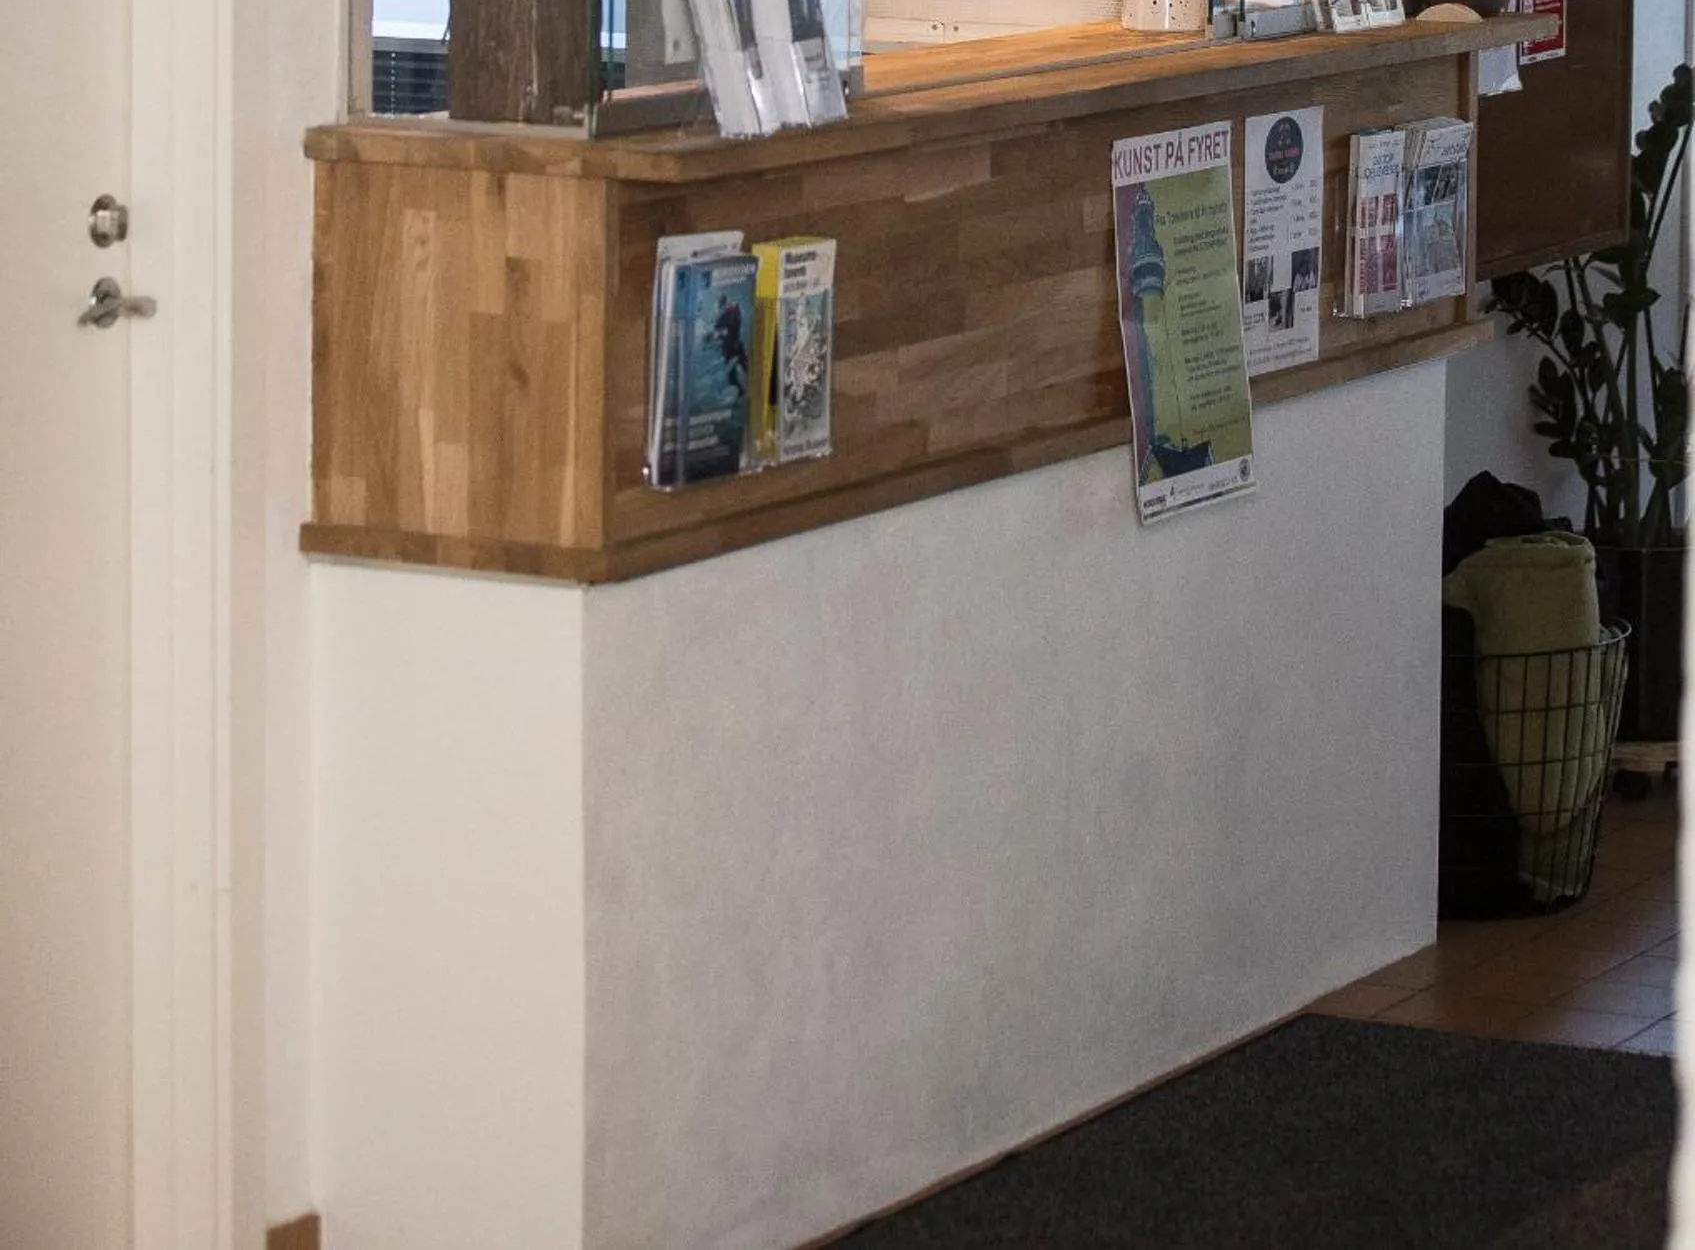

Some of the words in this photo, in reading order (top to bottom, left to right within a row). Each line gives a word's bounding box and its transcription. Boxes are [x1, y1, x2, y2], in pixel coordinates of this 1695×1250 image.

[1114, 144, 1162, 180] KUNST
[1165, 132, 1184, 169] PÅ
[1188, 130, 1229, 165] FYRET
